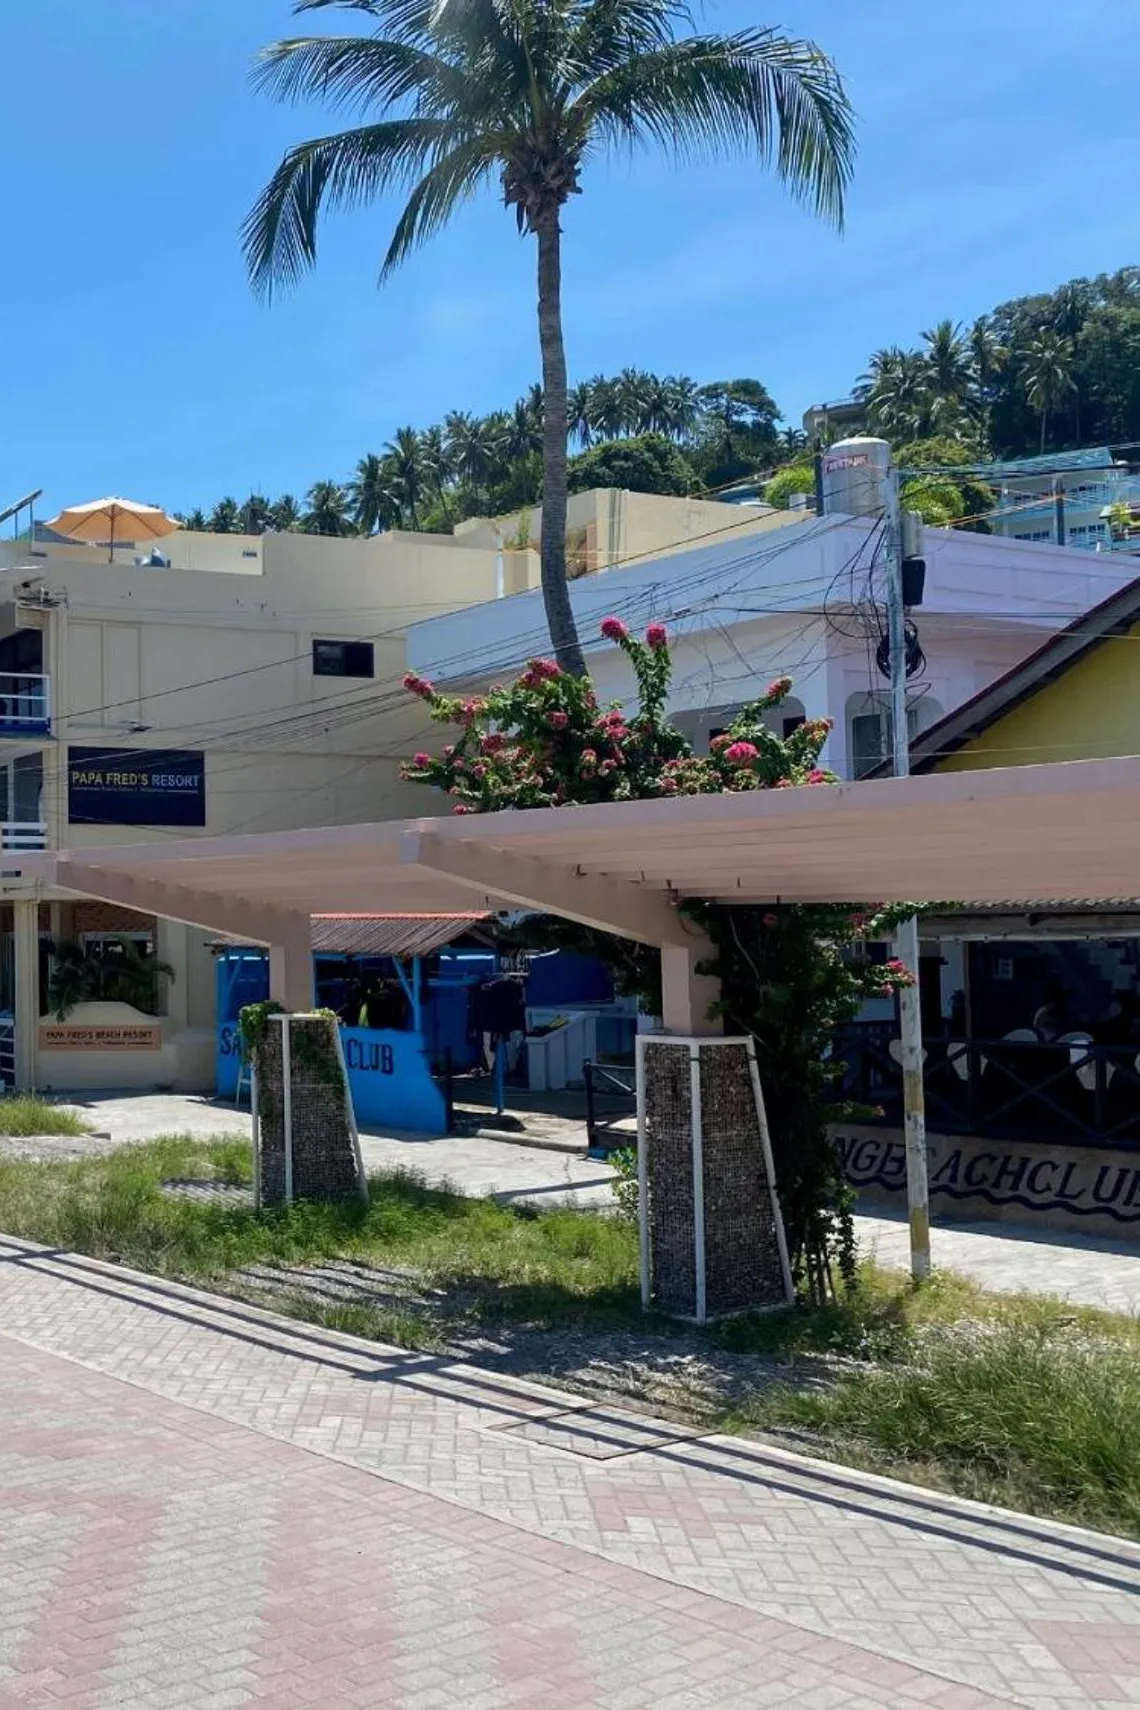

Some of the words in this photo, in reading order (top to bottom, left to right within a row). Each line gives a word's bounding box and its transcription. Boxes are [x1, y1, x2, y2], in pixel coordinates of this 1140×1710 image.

[72, 771, 103, 785] PAPA
[106, 772, 149, 786] FRED'S
[151, 774, 200, 787] RESORT
[346, 1038, 393, 1074] CLUB
